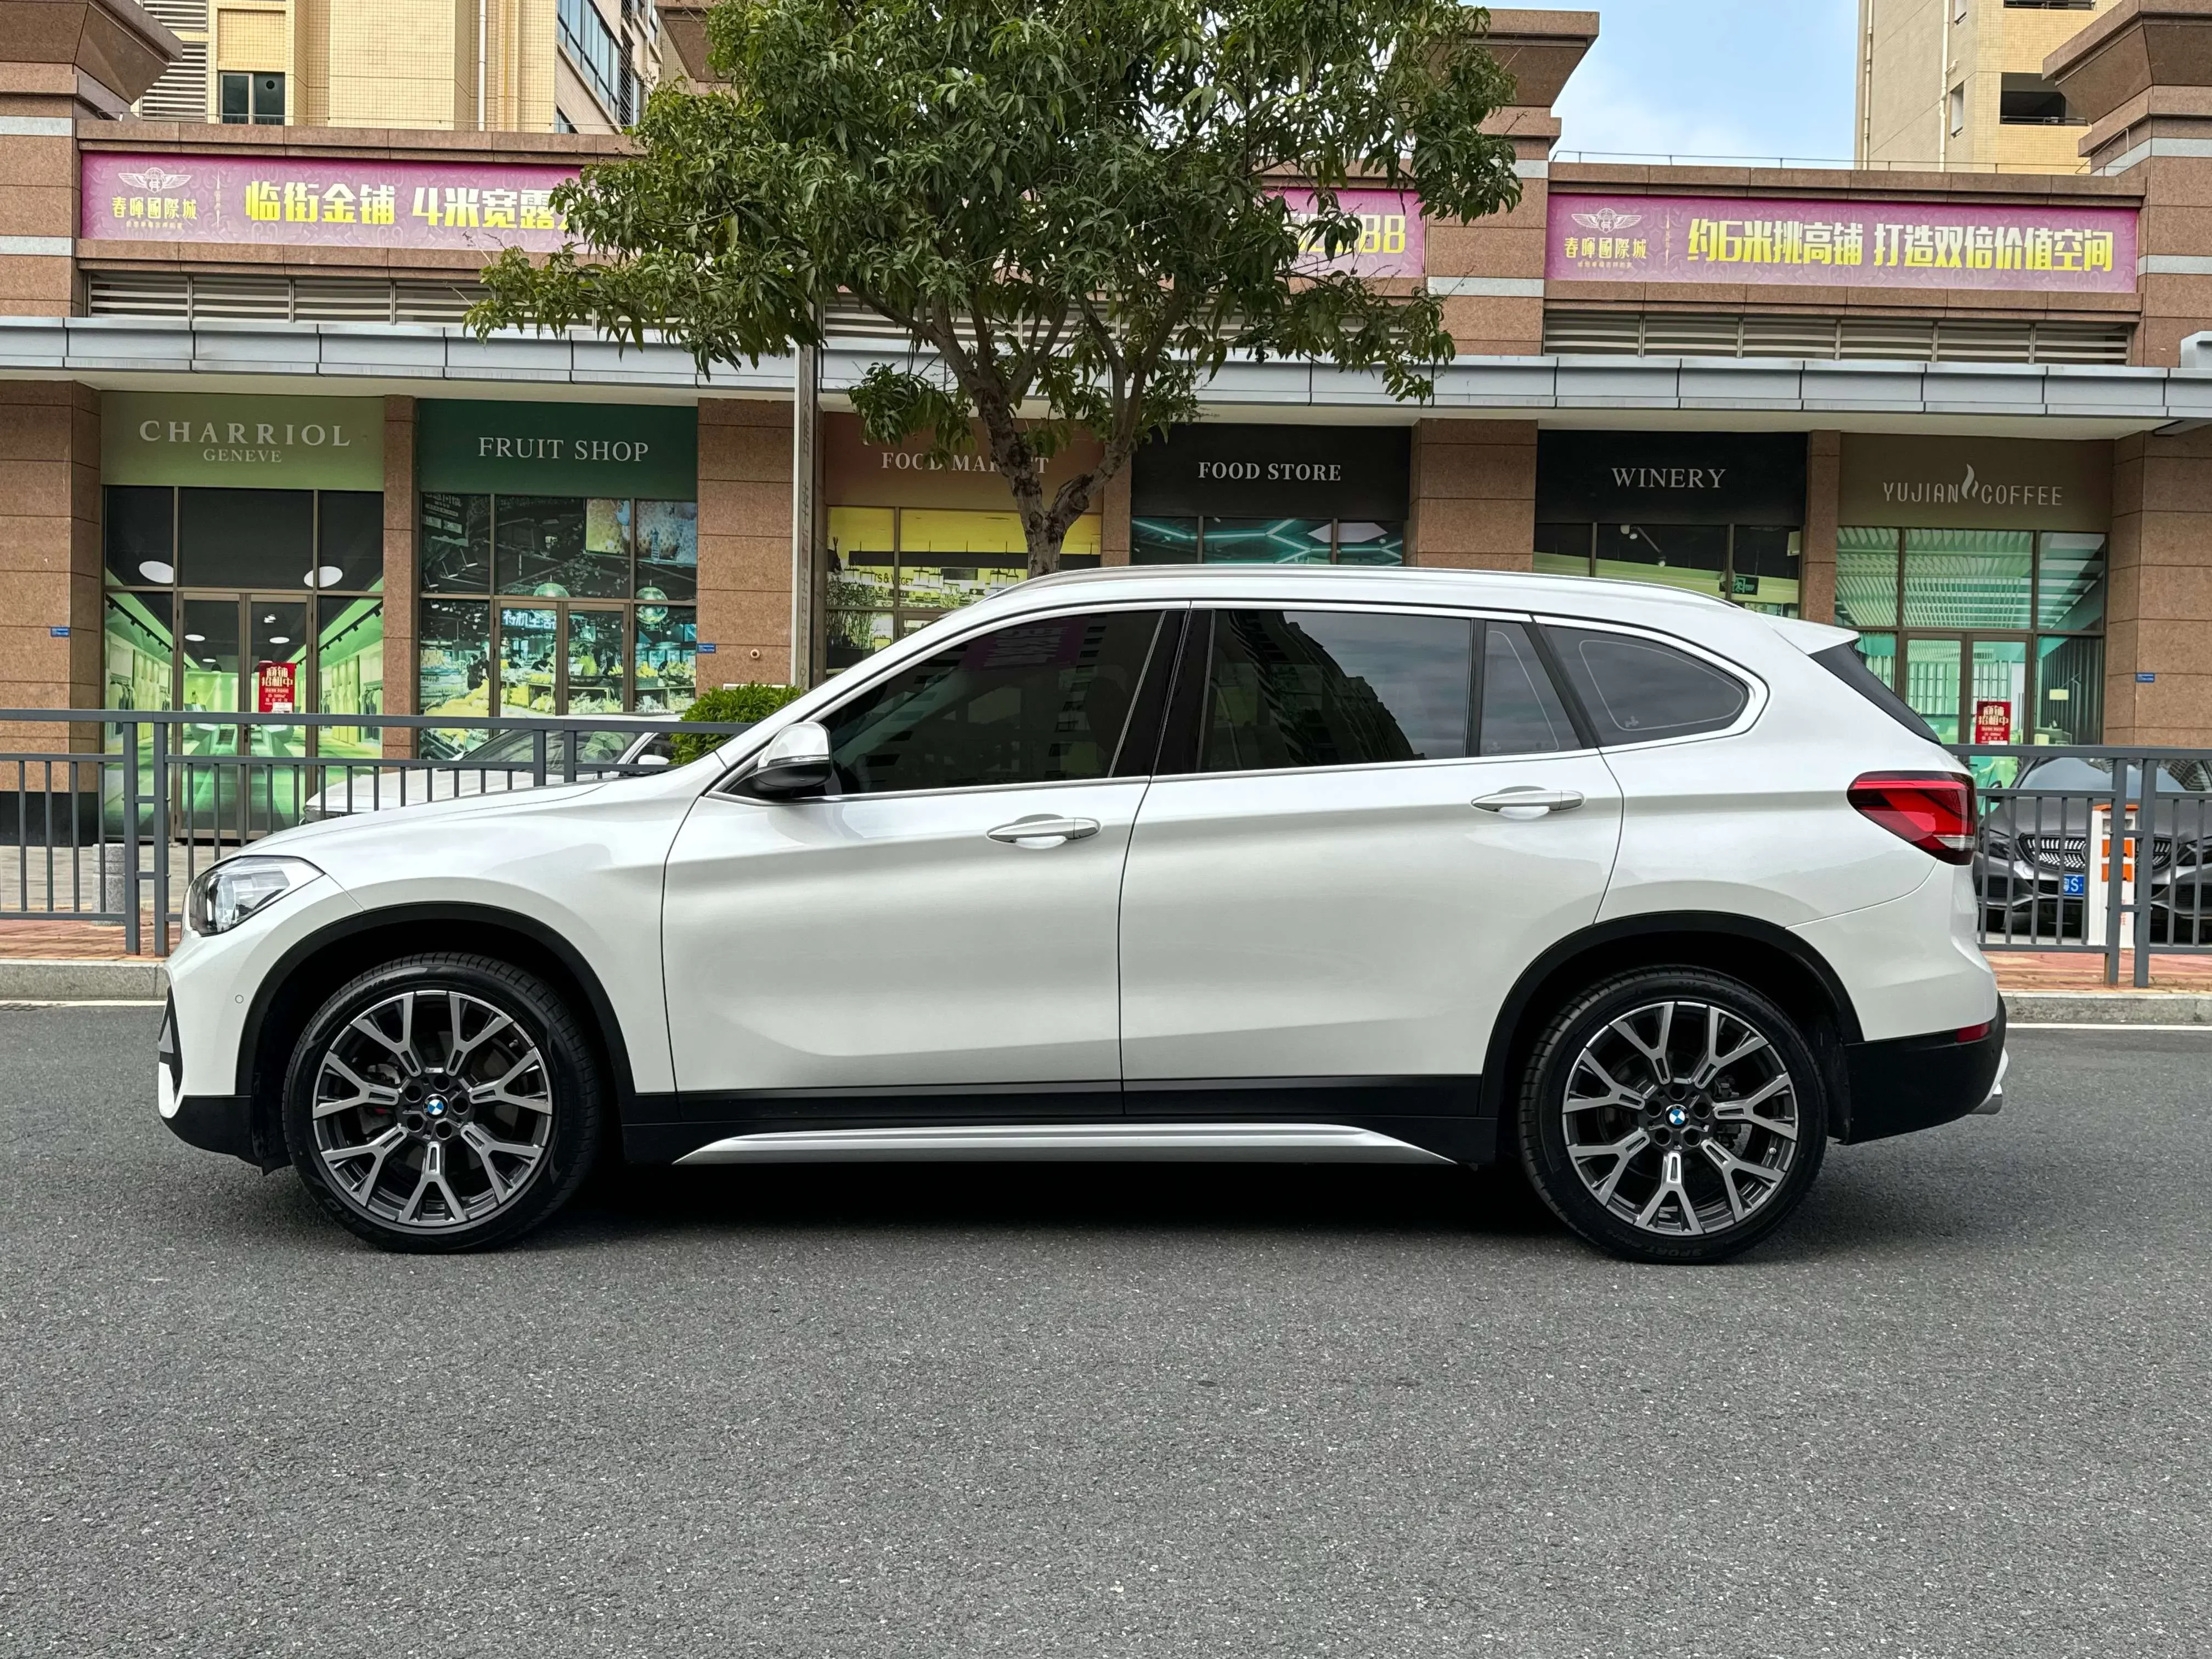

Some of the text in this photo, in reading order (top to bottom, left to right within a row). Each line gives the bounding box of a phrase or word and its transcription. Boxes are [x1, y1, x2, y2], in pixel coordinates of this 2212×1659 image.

[246, 181, 394, 225] 临街金铺
[413, 187, 571, 230] 4米宽露
[1688, 218, 2114, 272] 约6米挑高铺 打造双倍价值空间
[139, 420, 351, 447] CHARRIOL
[203, 448, 282, 463] GENEVE
[478, 437, 649, 462] FRUIT SHOP
[1198, 462, 1341, 481] FOOD STORE
[1611, 467, 1726, 488] WINERY
[1883, 482, 2063, 506] YUJIAN COFFEE
